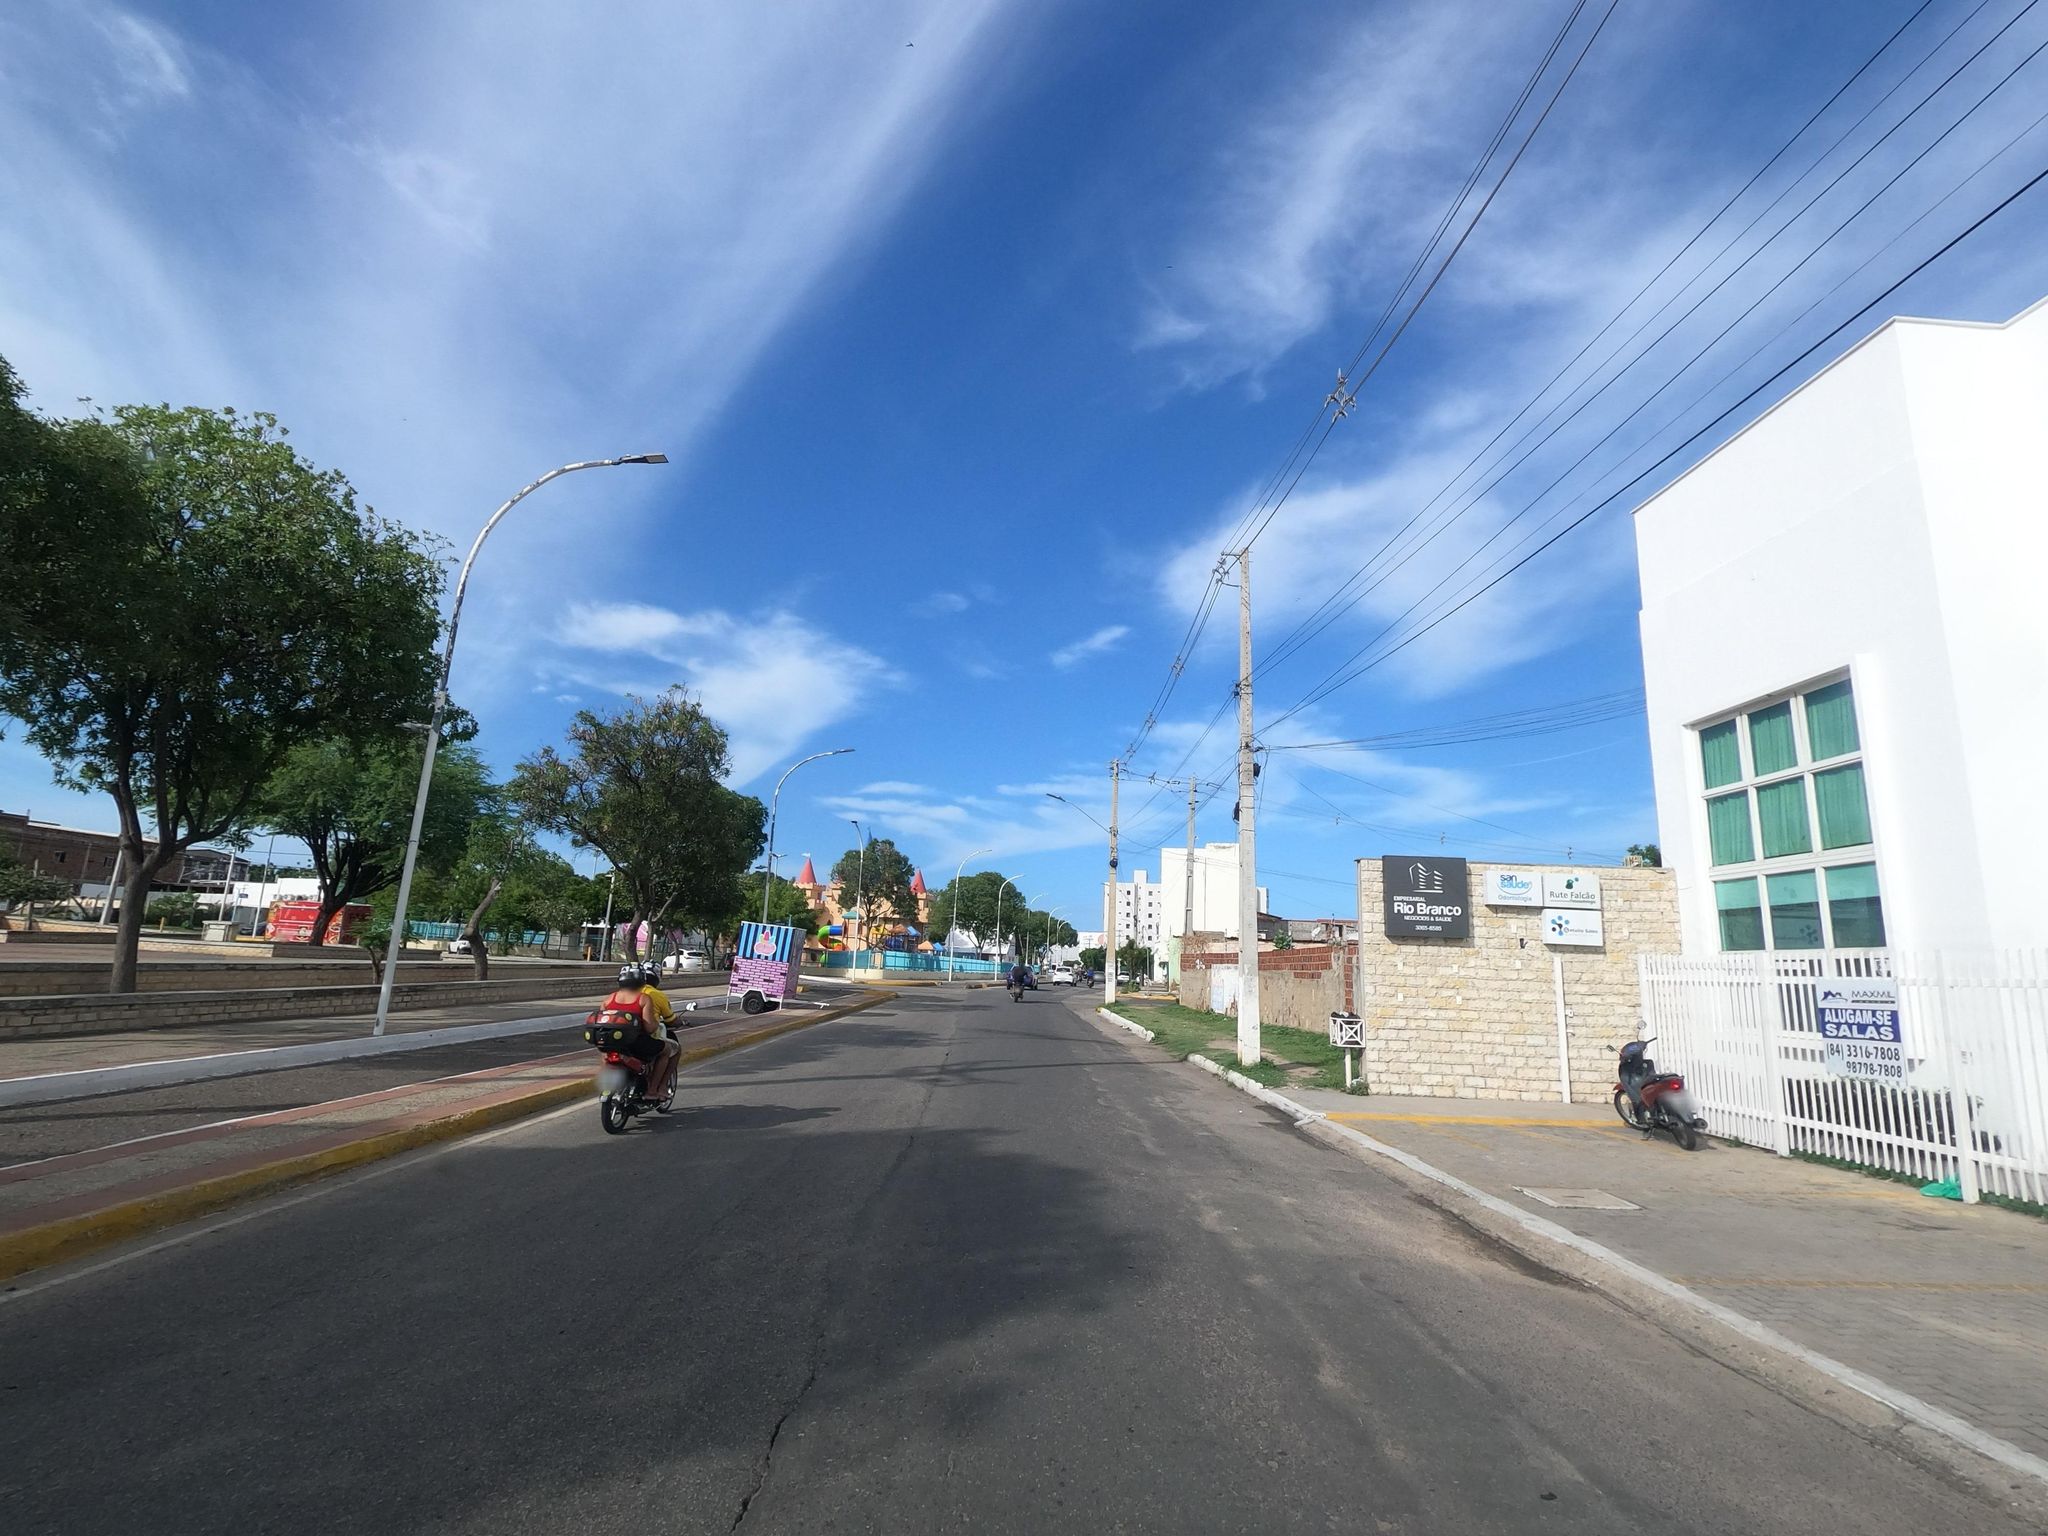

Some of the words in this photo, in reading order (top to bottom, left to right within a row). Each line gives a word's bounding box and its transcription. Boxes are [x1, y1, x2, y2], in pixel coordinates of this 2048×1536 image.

[1549, 891, 1569, 899] Rute
[1570, 891, 1596, 900] Falcão
[1393, 902, 1415, 914] Rio
[1416, 902, 1462, 916] Branco
[1851, 990, 1896, 999] MAXMIL
[1824, 1008, 1892, 1025] ALUGAM-SE
[1825, 1023, 1895, 1041] SALAS
[1826, 1043, 1844, 1060] (84)
[1846, 1044, 1901, 1061] 3316-7808
